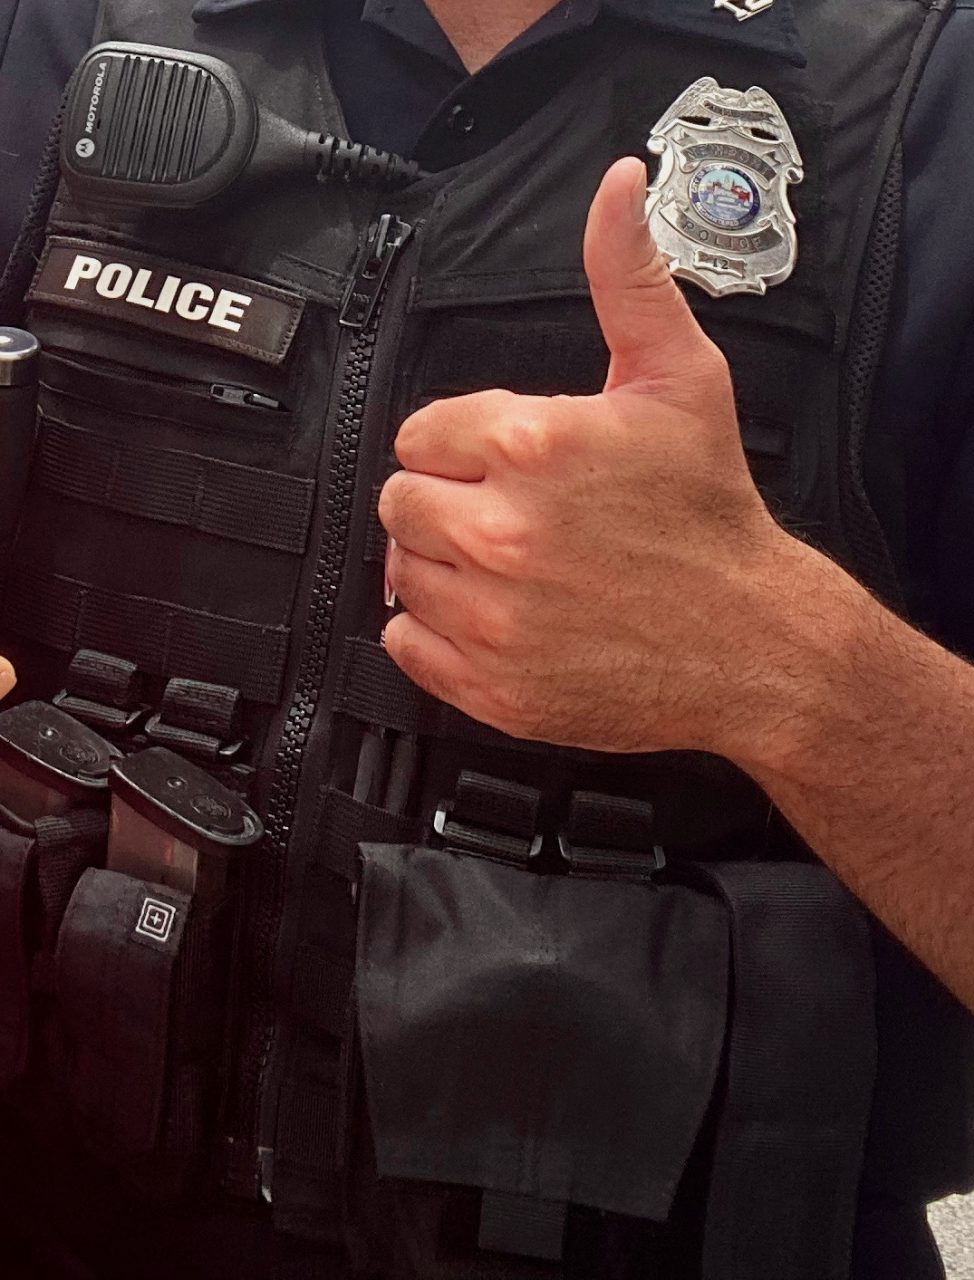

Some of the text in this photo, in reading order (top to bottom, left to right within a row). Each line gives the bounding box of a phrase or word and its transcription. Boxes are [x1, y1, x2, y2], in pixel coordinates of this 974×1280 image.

[85, 62, 107, 134] MOTOROLA
[63, 254, 253, 333] POLICE
[712, 258, 729, 269] 12
